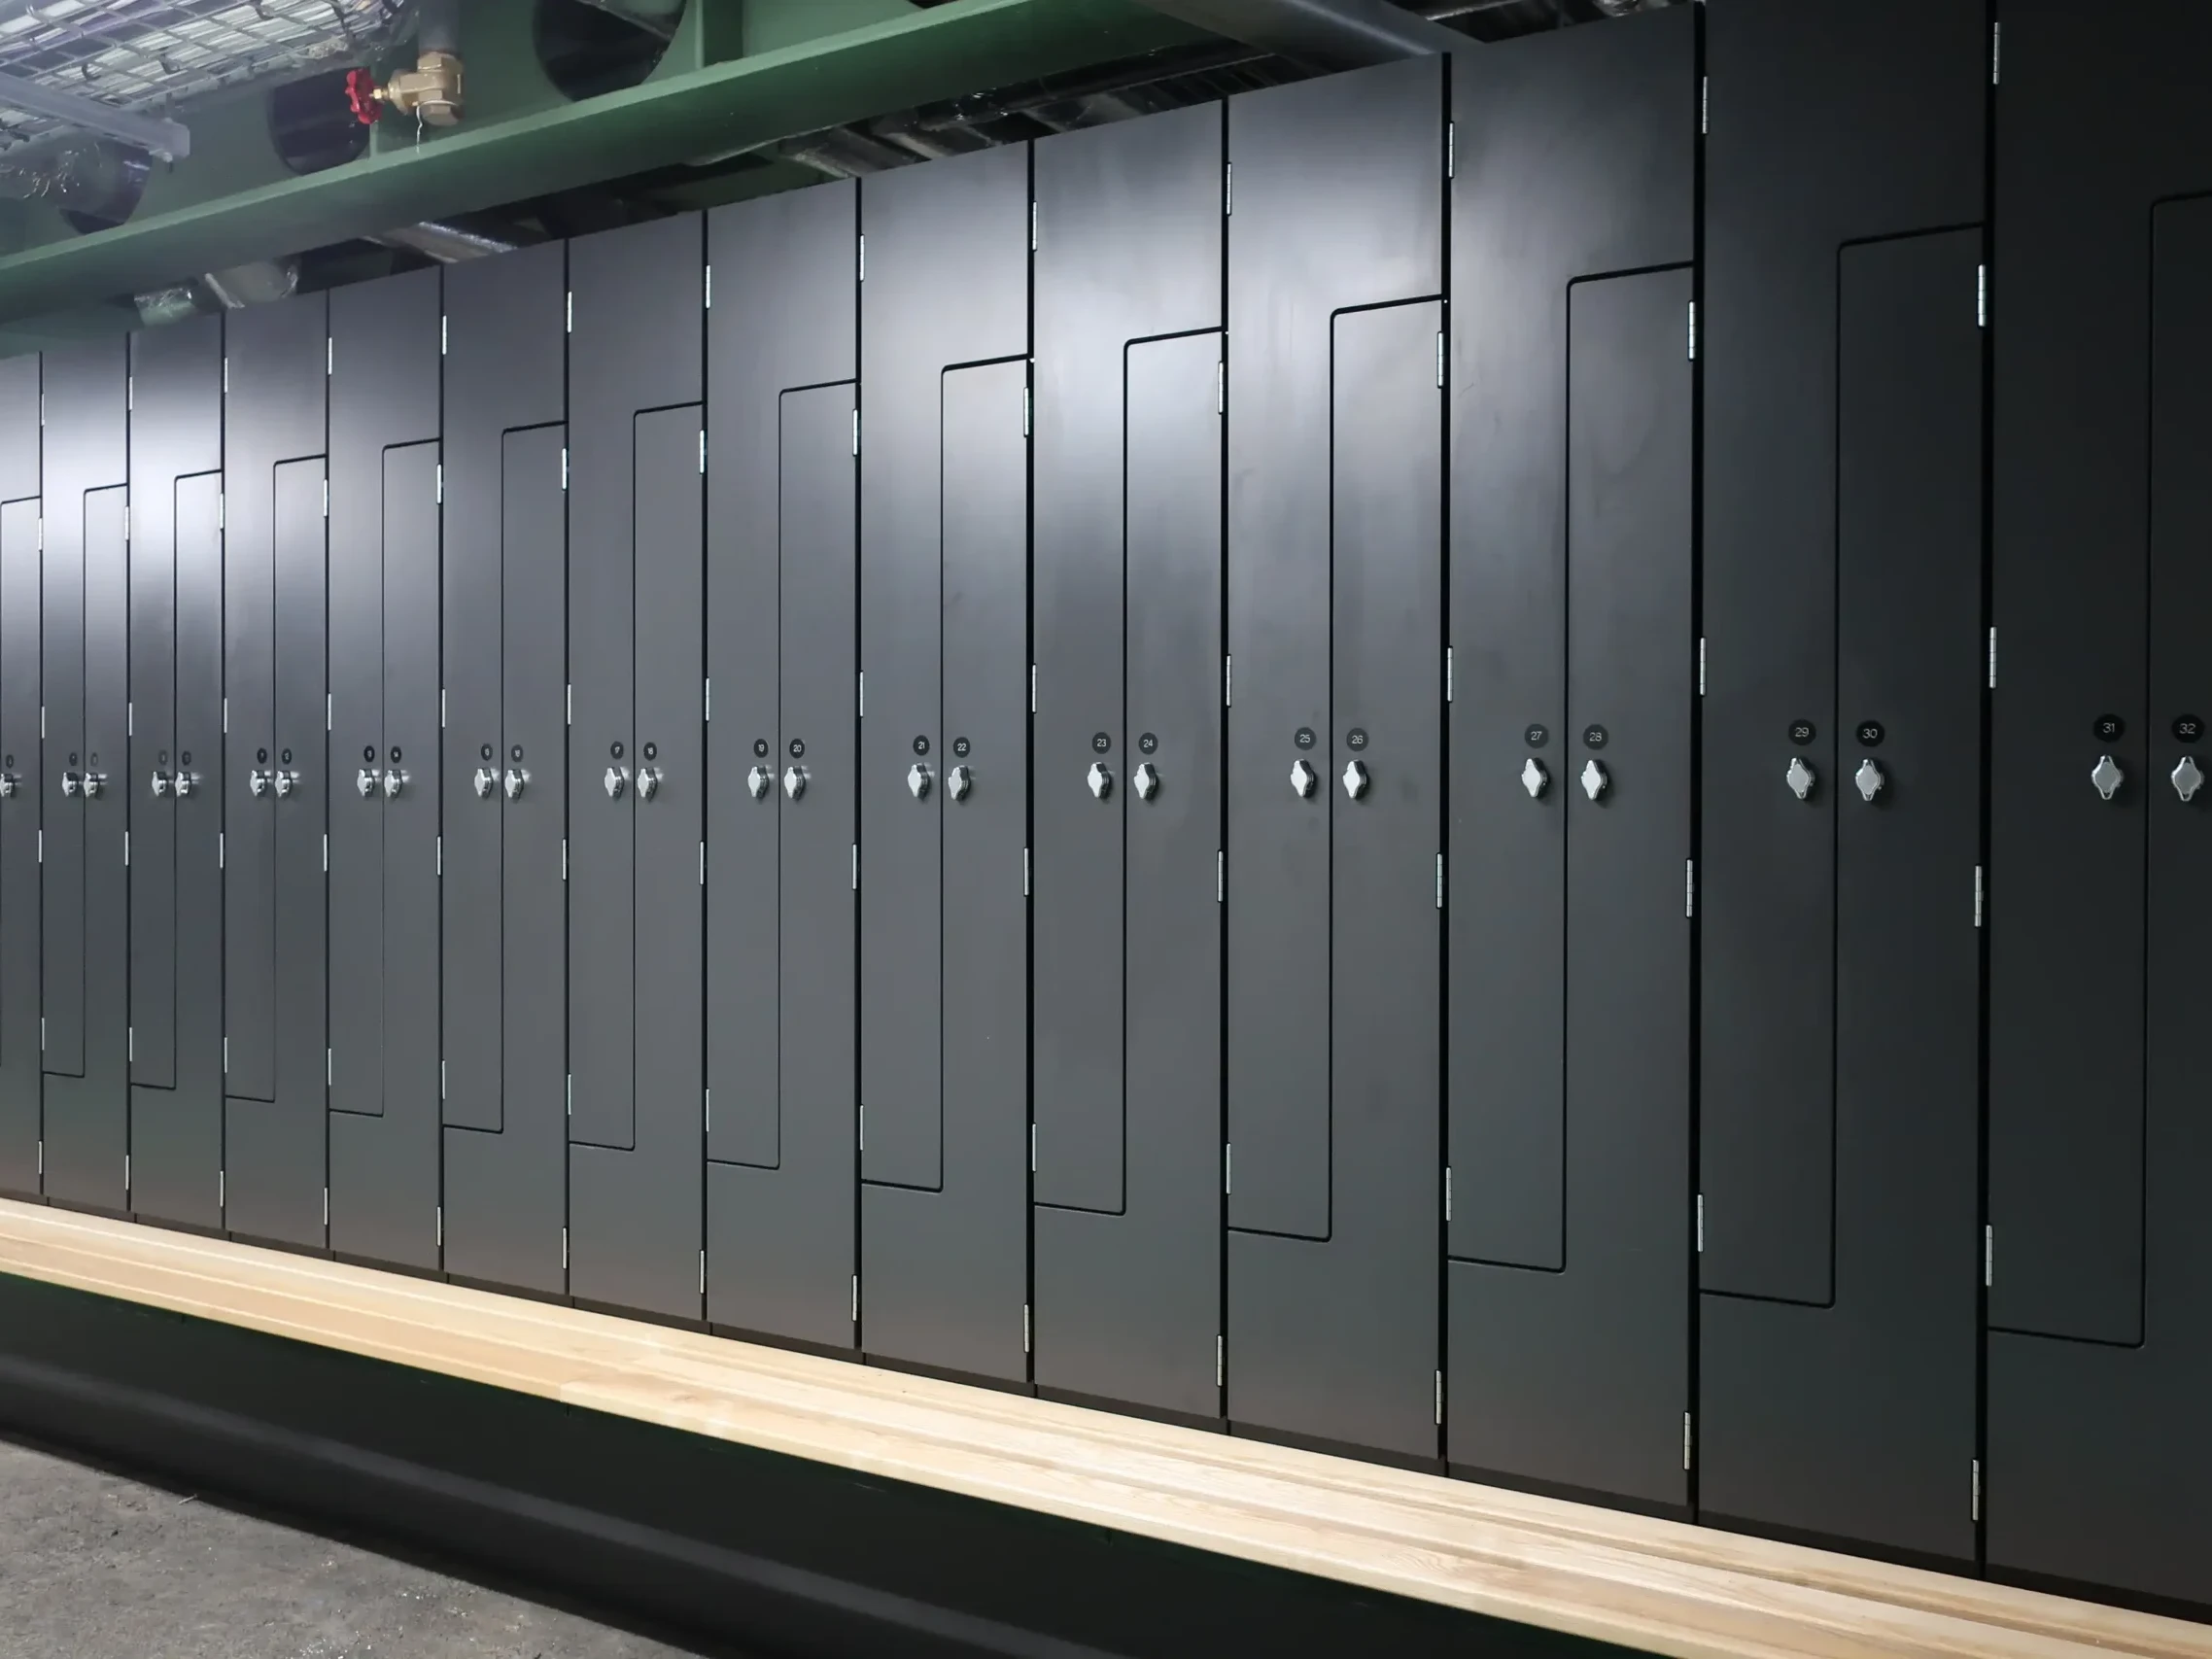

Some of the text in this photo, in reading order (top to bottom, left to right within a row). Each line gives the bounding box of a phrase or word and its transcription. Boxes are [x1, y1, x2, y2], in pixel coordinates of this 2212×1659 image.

[1794, 727, 1810, 738] 29
[2103, 722, 2115, 734] 31
[2179, 722, 2196, 735] 32
[1299, 734, 1311, 743] 25
[1531, 730, 1542, 741] 27
[1589, 732, 1603, 742] 28
[1862, 728, 1878, 740] 30
[1096, 738, 1107, 747] 23
[1143, 739, 1154, 748] 24
[1351, 735, 1364, 744] 26
[793, 743, 802, 753] 20
[917, 741, 925, 750] 21
[957, 743, 967, 752] 22
